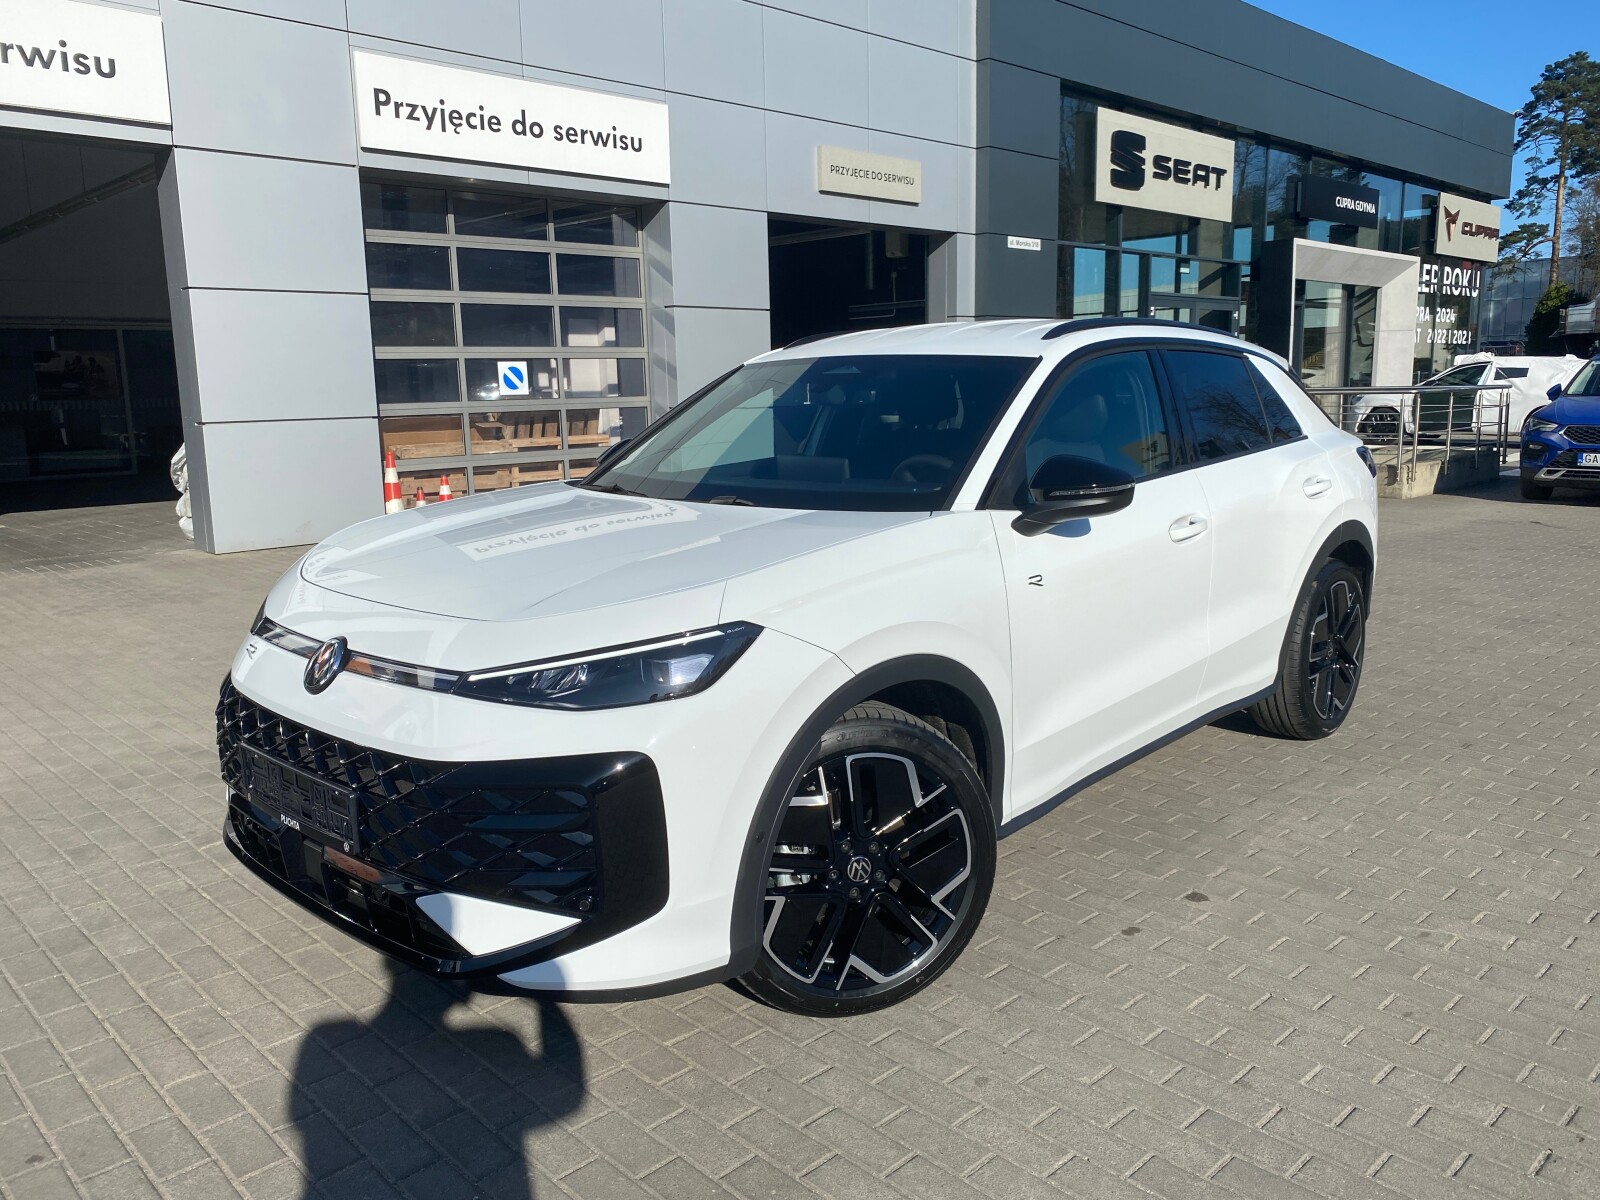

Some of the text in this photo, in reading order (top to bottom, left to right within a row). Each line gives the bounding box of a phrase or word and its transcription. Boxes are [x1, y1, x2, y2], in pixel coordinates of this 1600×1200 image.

[0, 39, 116, 78] rwisu
[373, 87, 643, 153] Przyjęcie do serwisu
[830, 164, 915, 186] PRZYJĘCIE DO SERWISU
[1152, 154, 1227, 191] SEAT
[1335, 196, 1376, 214] CUPRA GDYNIA
[1461, 222, 1499, 241] CUPRA
[1443, 266, 1480, 297] ROKU
[1436, 307, 1455, 324] 2024
[280, 813, 300, 831] PLICHTA
